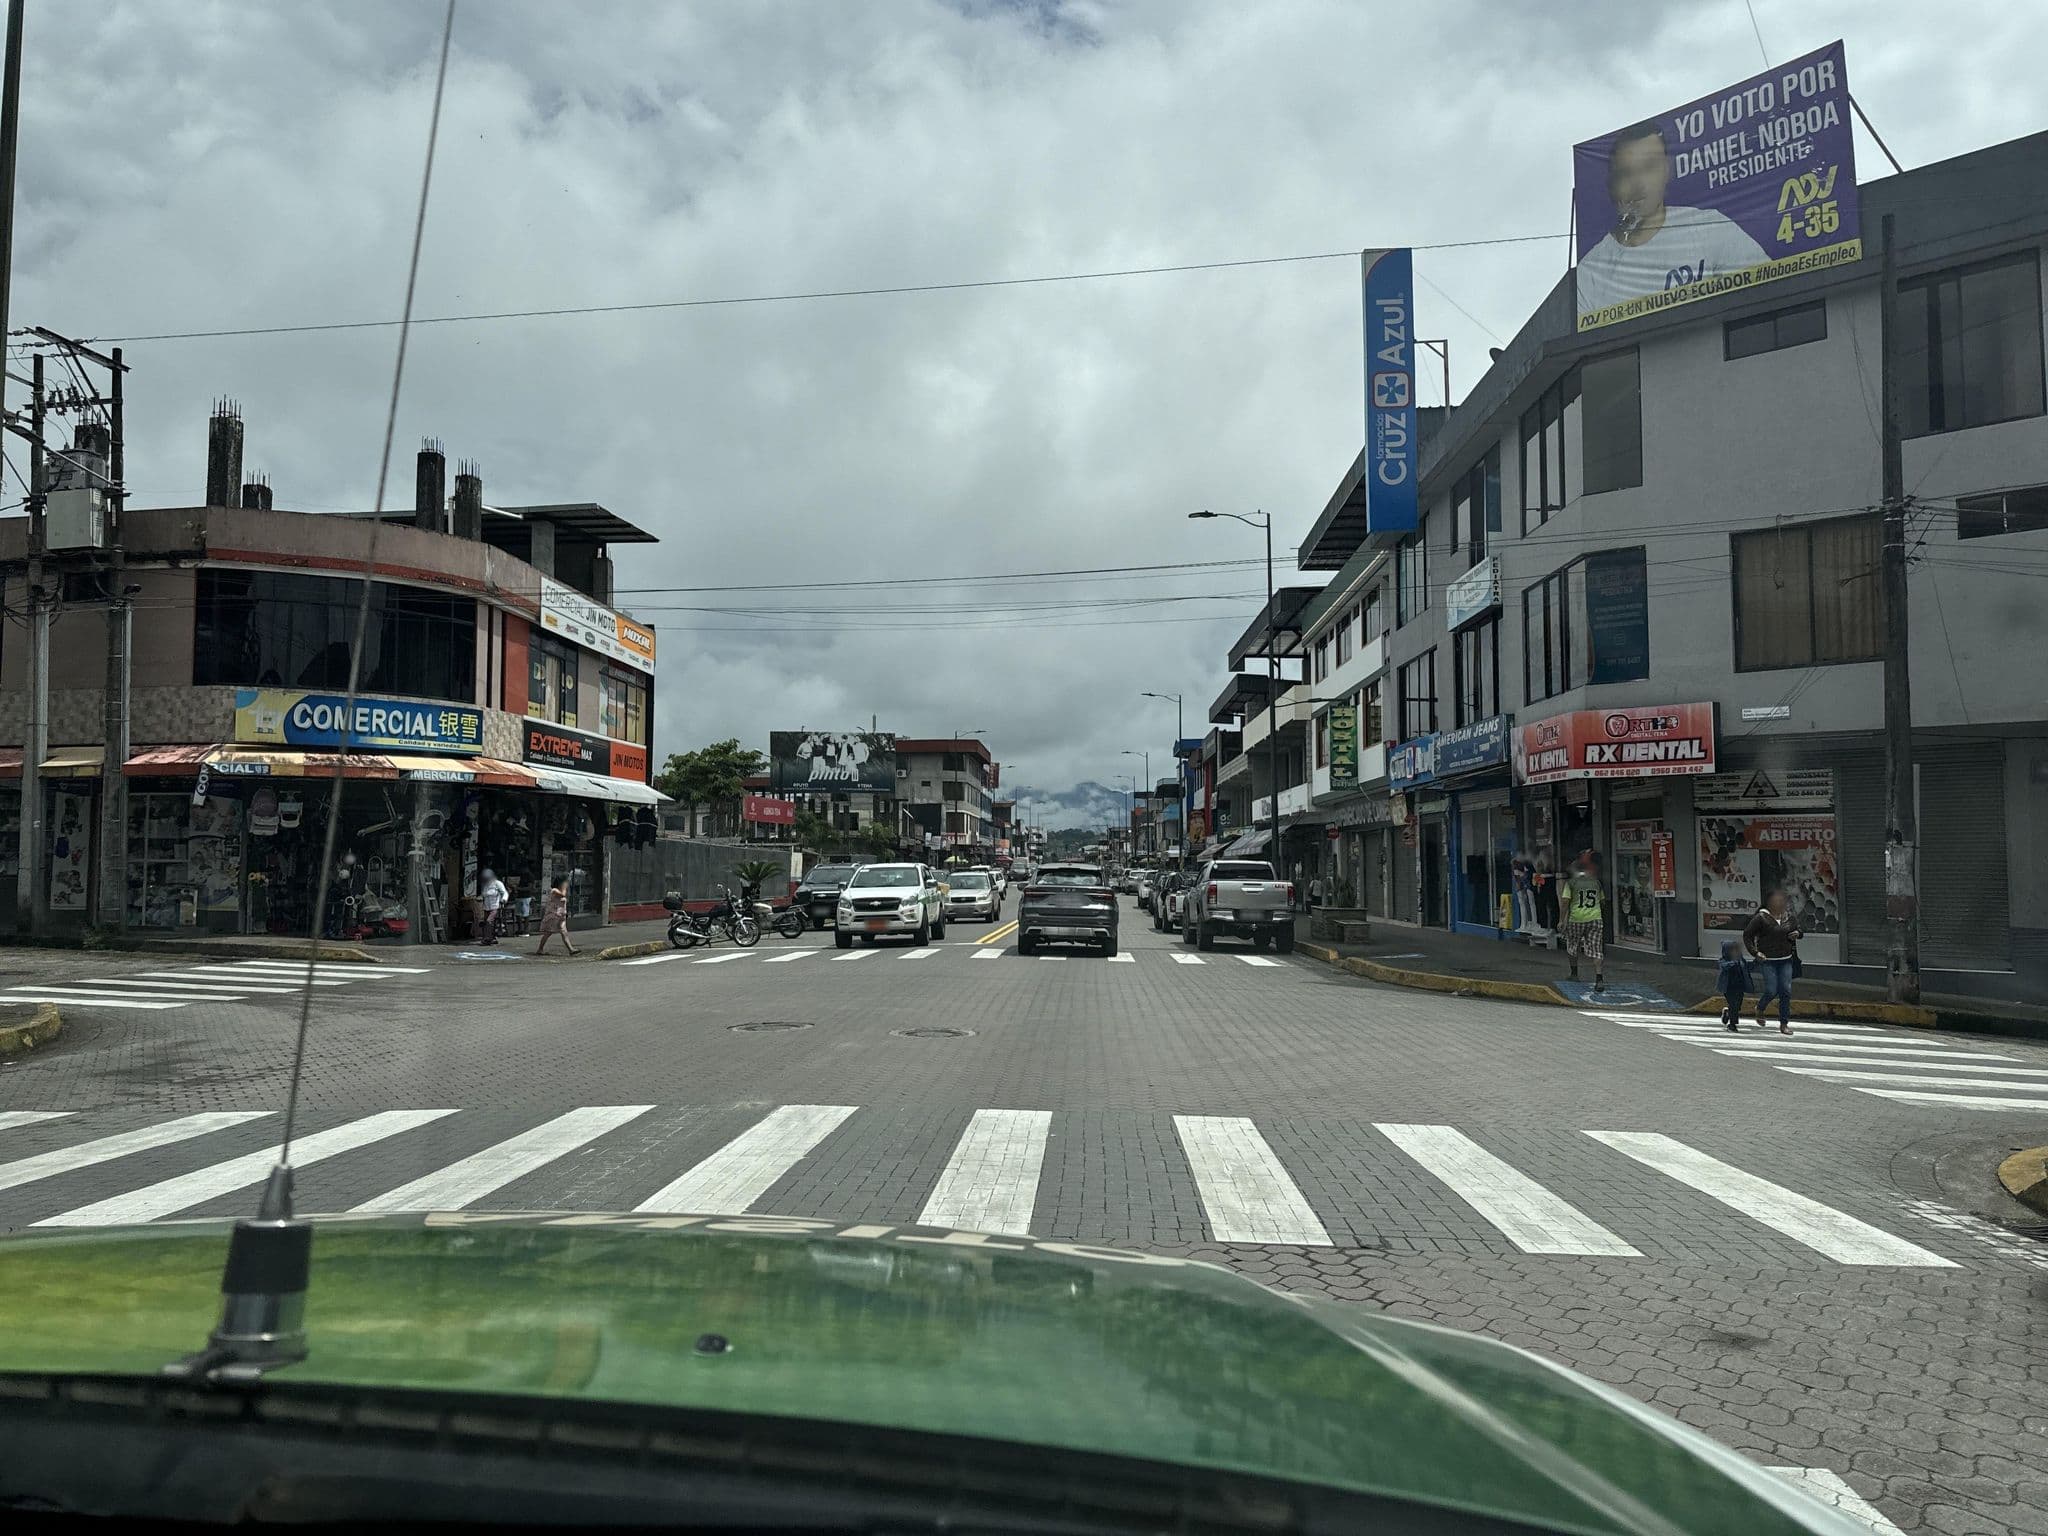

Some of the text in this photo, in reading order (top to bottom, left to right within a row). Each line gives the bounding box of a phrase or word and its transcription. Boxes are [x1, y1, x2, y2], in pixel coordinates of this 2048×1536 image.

[1675, 59, 1837, 143] YO VOTO POR
[1675, 101, 1840, 179] DANIEL NOBOA
[1708, 144, 1808, 189] PRESIDENTE
[1776, 200, 1839, 244] 4-35
[1602, 307, 1624, 323] POR
[1627, 302, 1643, 317] UN
[1645, 286, 1688, 312] NUEVO
[1692, 270, 1752, 299] ECUADOR
[1755, 246, 1857, 283] #NoboaEsEmpleo
[1376, 298, 1408, 487] Cruz Azul
[1492, 556, 1500, 602] PEDIATRA
[545, 585, 585, 619] COMERCIAL
[586, 607, 597, 625] JIN
[598, 613, 616, 633] MOTO
[292, 702, 479, 739] COMERCIAL 银雪
[1437, 729, 1472, 748] AMERICAN
[1473, 718, 1500, 737] JEANS
[398, 739, 427, 747] Calidad
[530, 732, 582, 759] EXTREME
[581, 749, 593, 761] MAX
[1331, 706, 1356, 777] HOSTAL
[1586, 738, 1707, 763] RX DENTAL
[411, 769, 464, 781] MERCIAL
[613, 753, 644, 770] JIN MOTOS
[808, 768, 850, 783] pinto
[1529, 748, 1569, 772] RX DENTAL
[1759, 829, 1835, 841] ABIERTO
[1577, 889, 1597, 908] 15
